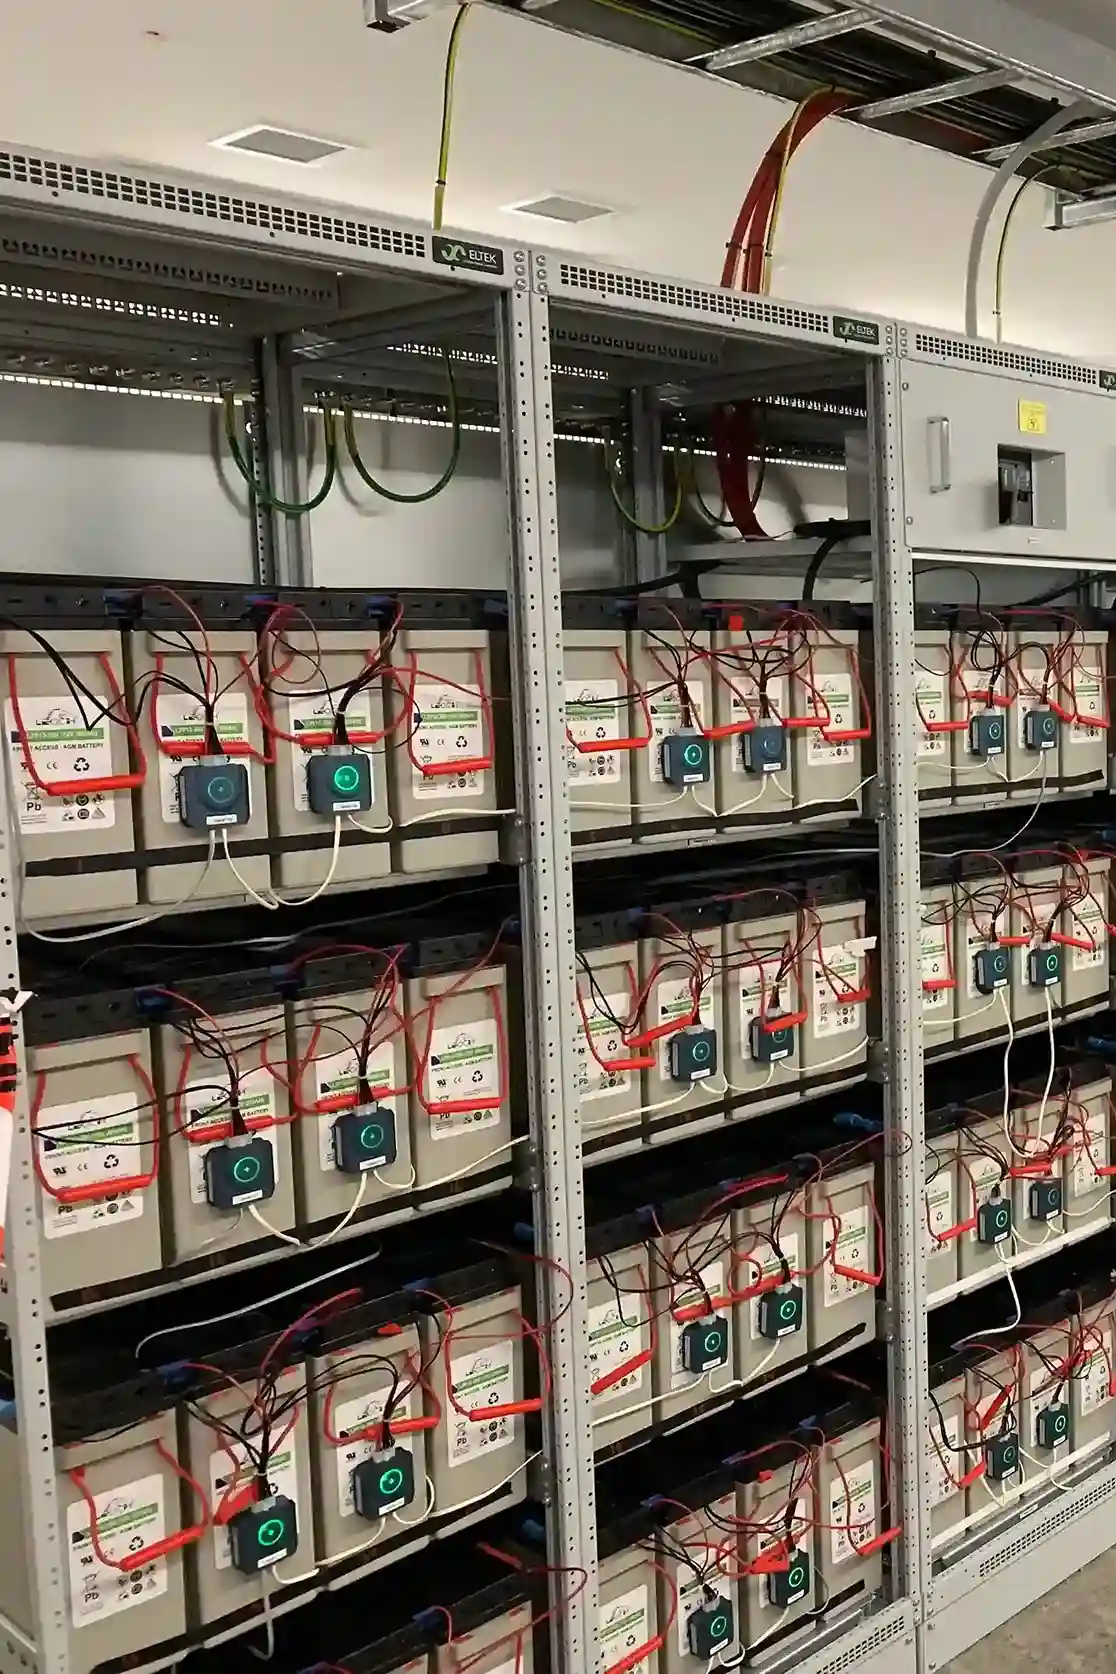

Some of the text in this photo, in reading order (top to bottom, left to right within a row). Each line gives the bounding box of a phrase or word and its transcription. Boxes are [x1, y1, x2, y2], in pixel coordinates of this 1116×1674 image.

[469, 249, 497, 264] ELTEK
[856, 325, 877, 337] ELTEK
[26, 801, 42, 812] Pb
